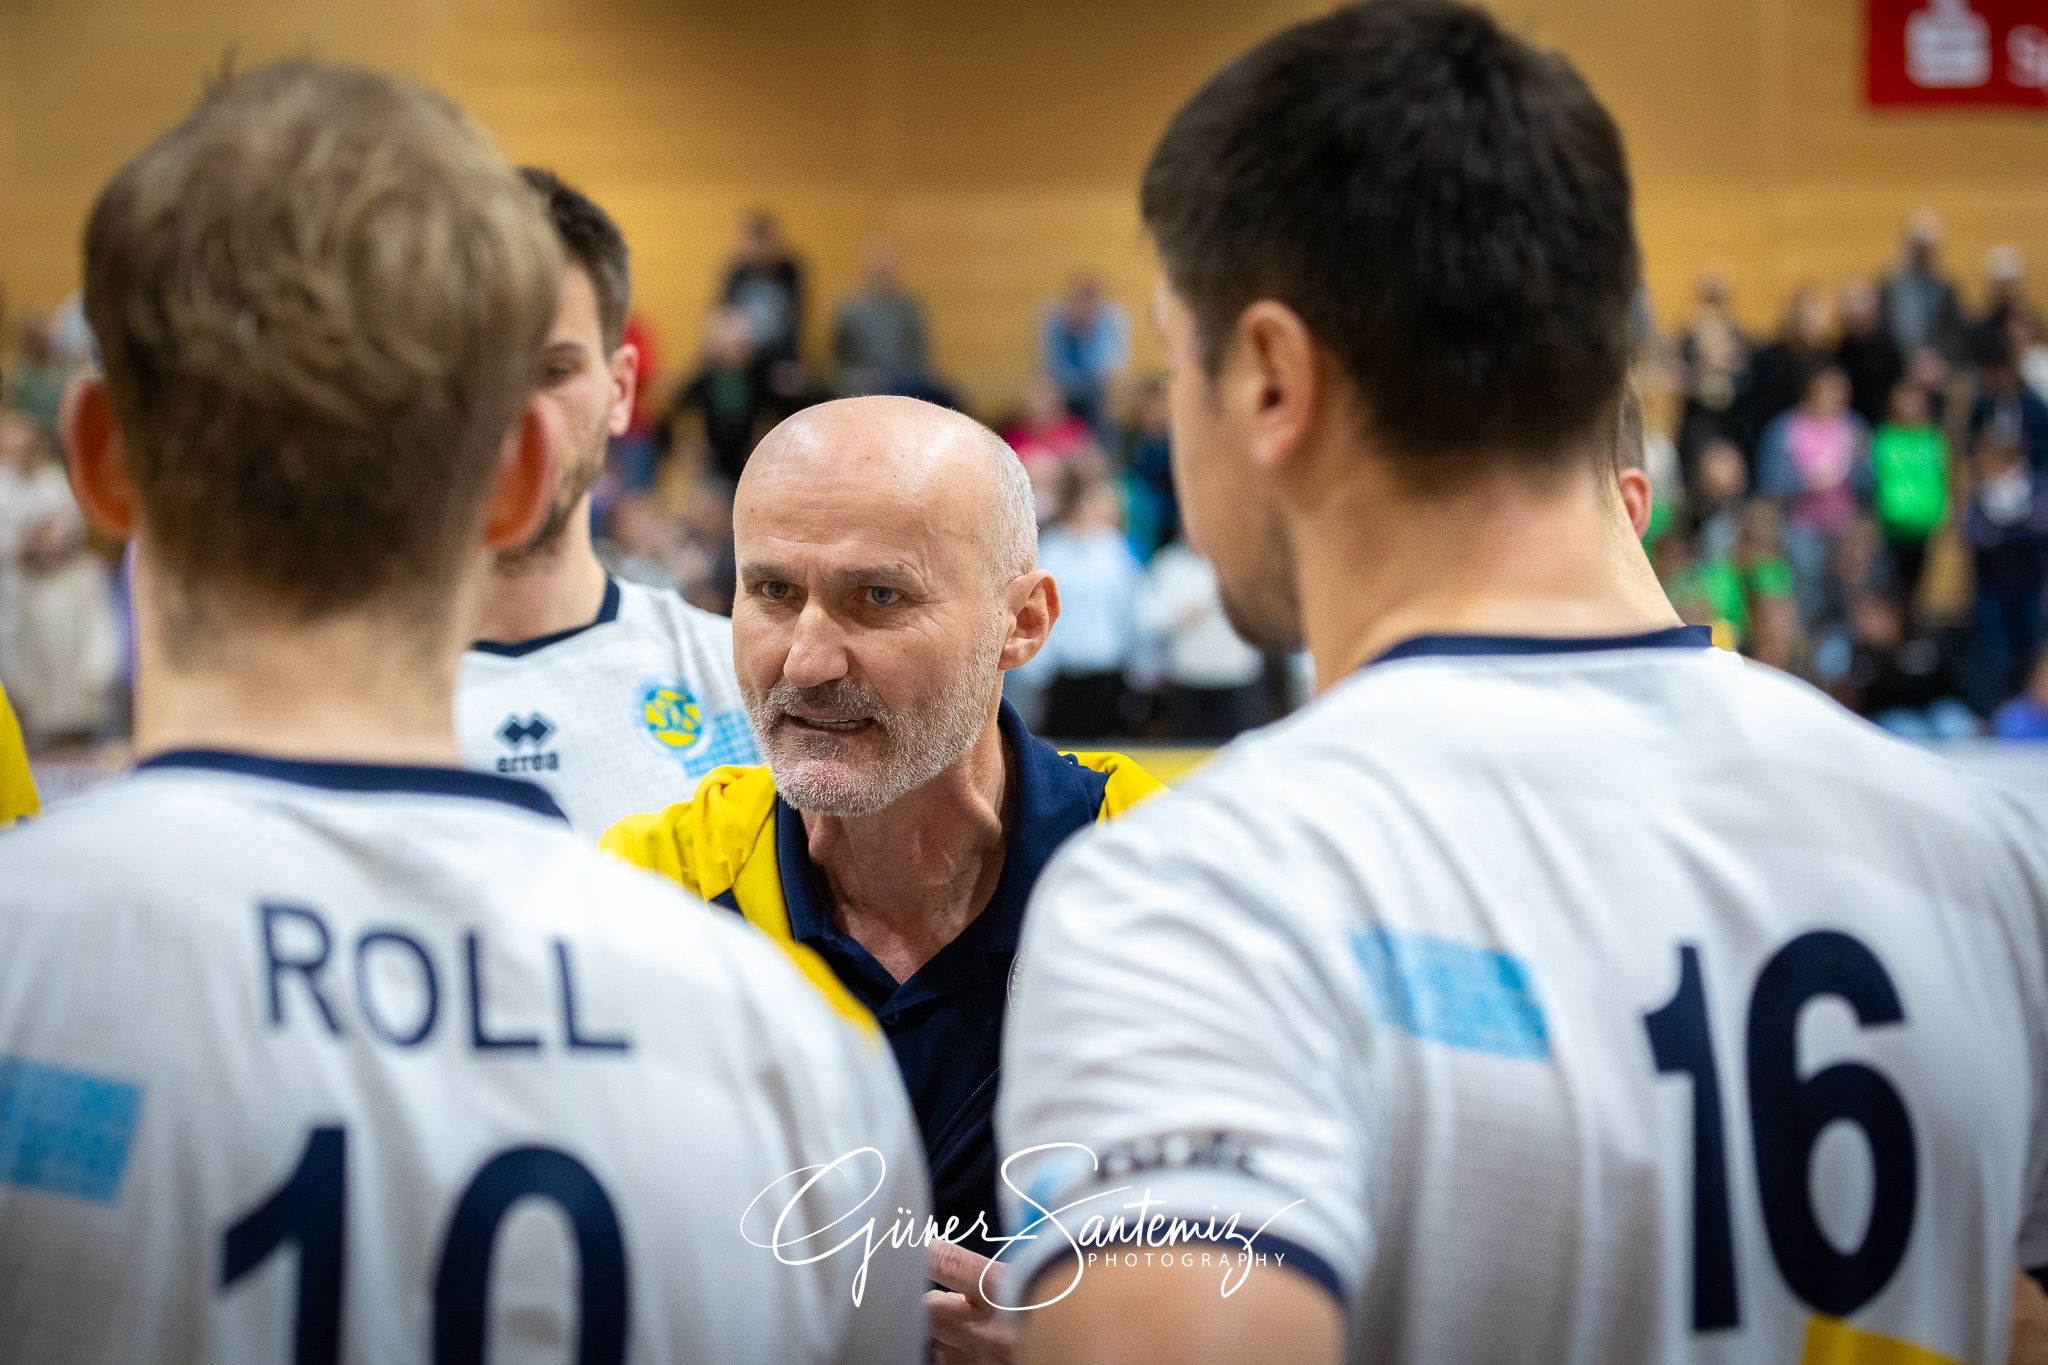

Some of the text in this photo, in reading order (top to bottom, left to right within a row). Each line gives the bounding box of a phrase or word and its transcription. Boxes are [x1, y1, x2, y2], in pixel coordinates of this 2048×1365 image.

[257, 900, 634, 1053] ROLL
[221, 1123, 629, 1365] 10
[1640, 929, 1919, 1332] 16
